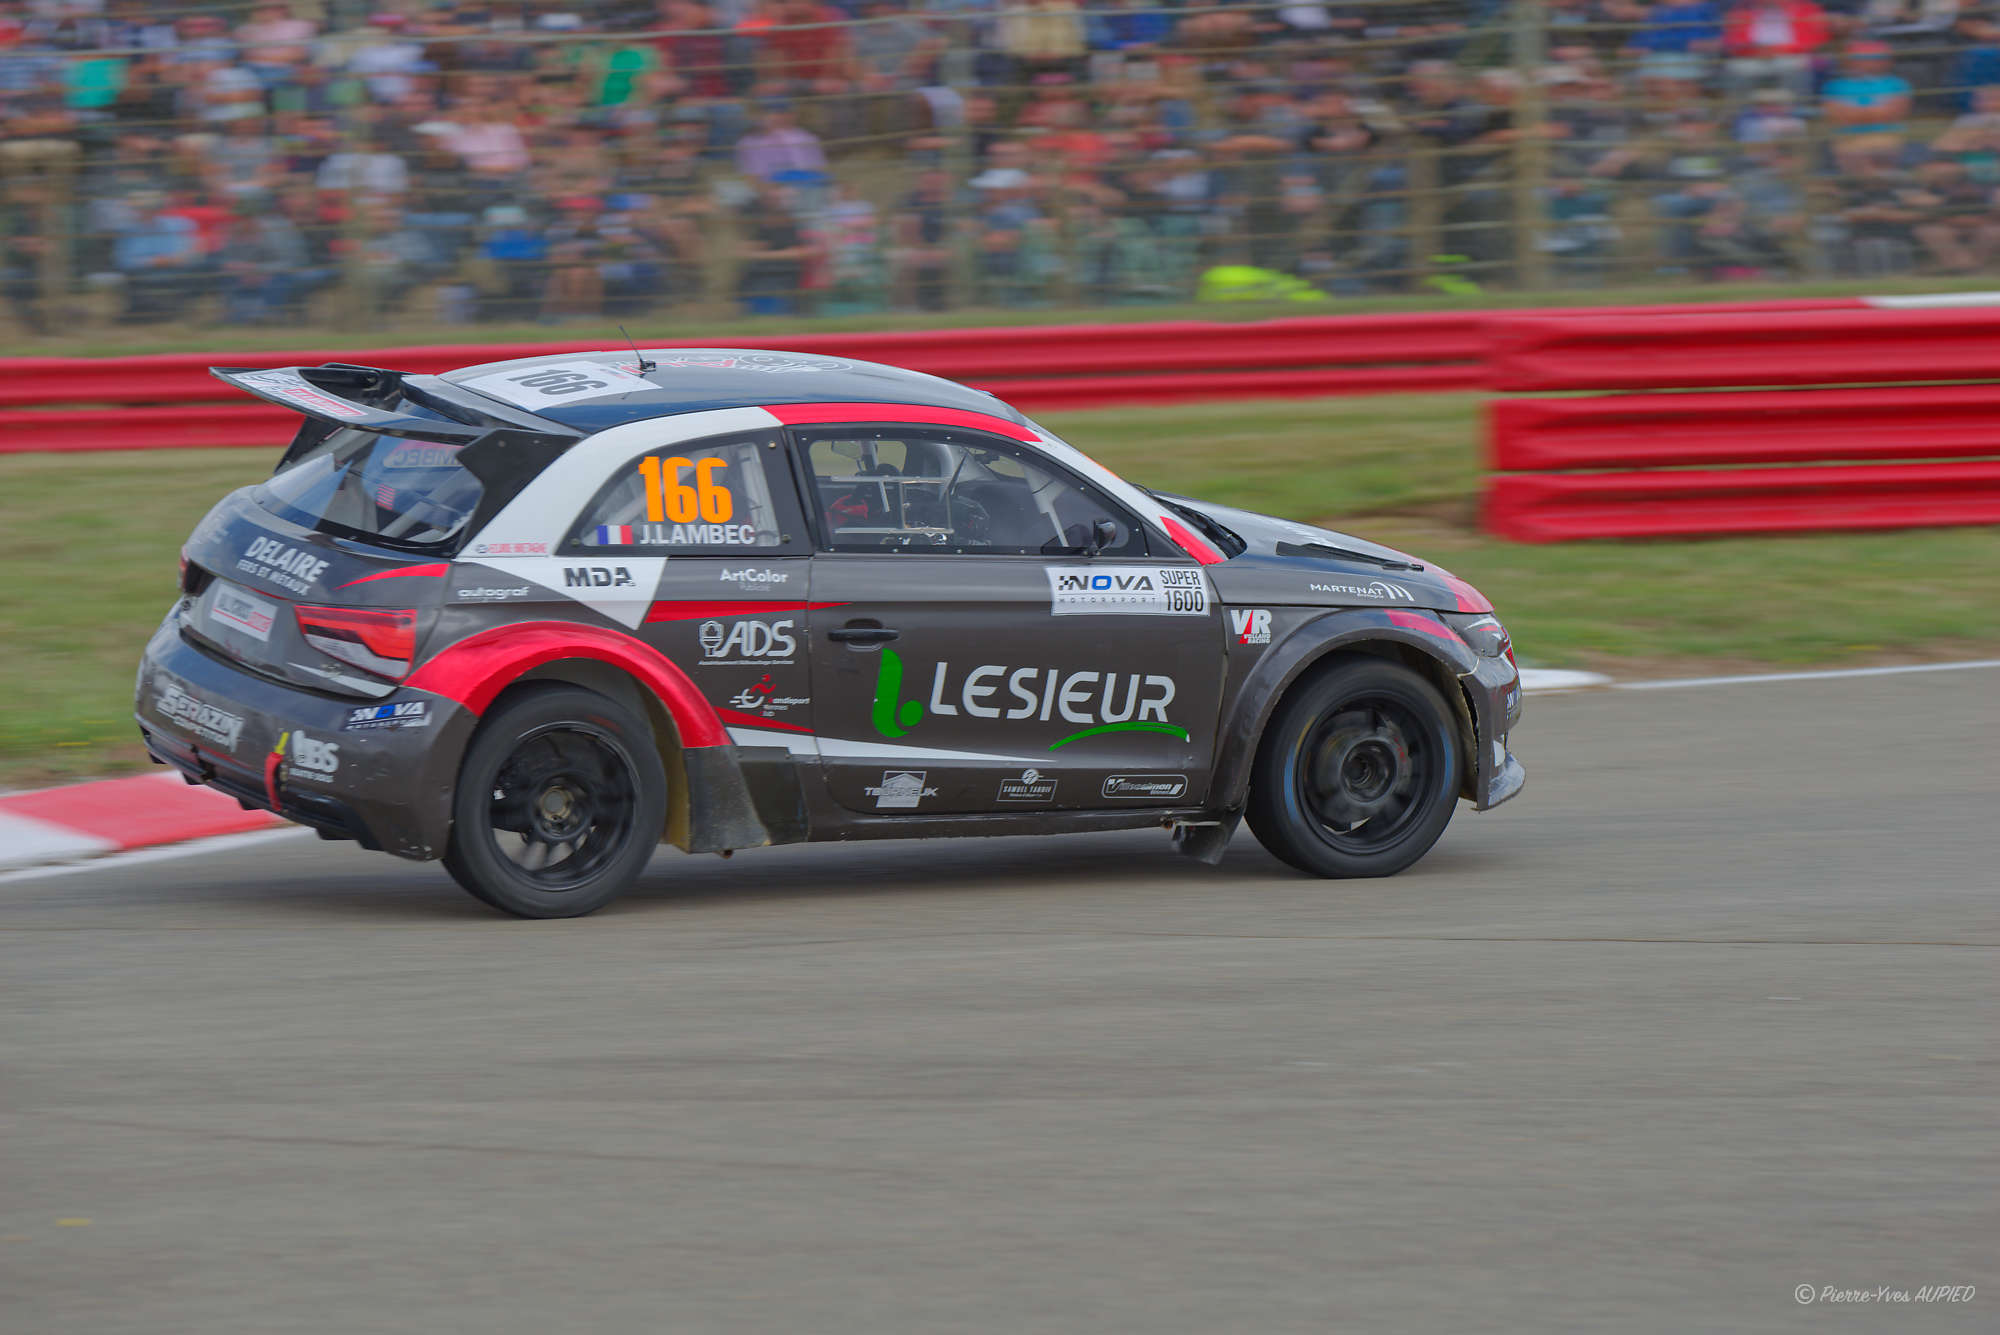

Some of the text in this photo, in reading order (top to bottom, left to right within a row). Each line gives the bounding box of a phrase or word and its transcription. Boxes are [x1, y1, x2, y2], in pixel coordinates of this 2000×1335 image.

[505, 367, 608, 397] 166
[638, 456, 733, 524] 166
[639, 524, 756, 545] J.LAMBEC
[243, 536, 331, 583] DELAIRE
[563, 567, 637, 587] MDA
[719, 568, 789, 583] ArtColor
[1065, 575, 1154, 591] NOVA
[1159, 570, 1201, 586] SUPER
[457, 586, 530, 600] autograf
[1309, 583, 1384, 596] MARTENAT
[1059, 596, 1156, 605] MOTORSPORT
[1164, 590, 1204, 612] 1600
[1230, 609, 1273, 635] VR
[713, 619, 797, 658] ADS
[929, 661, 1176, 724] LESIEUR
